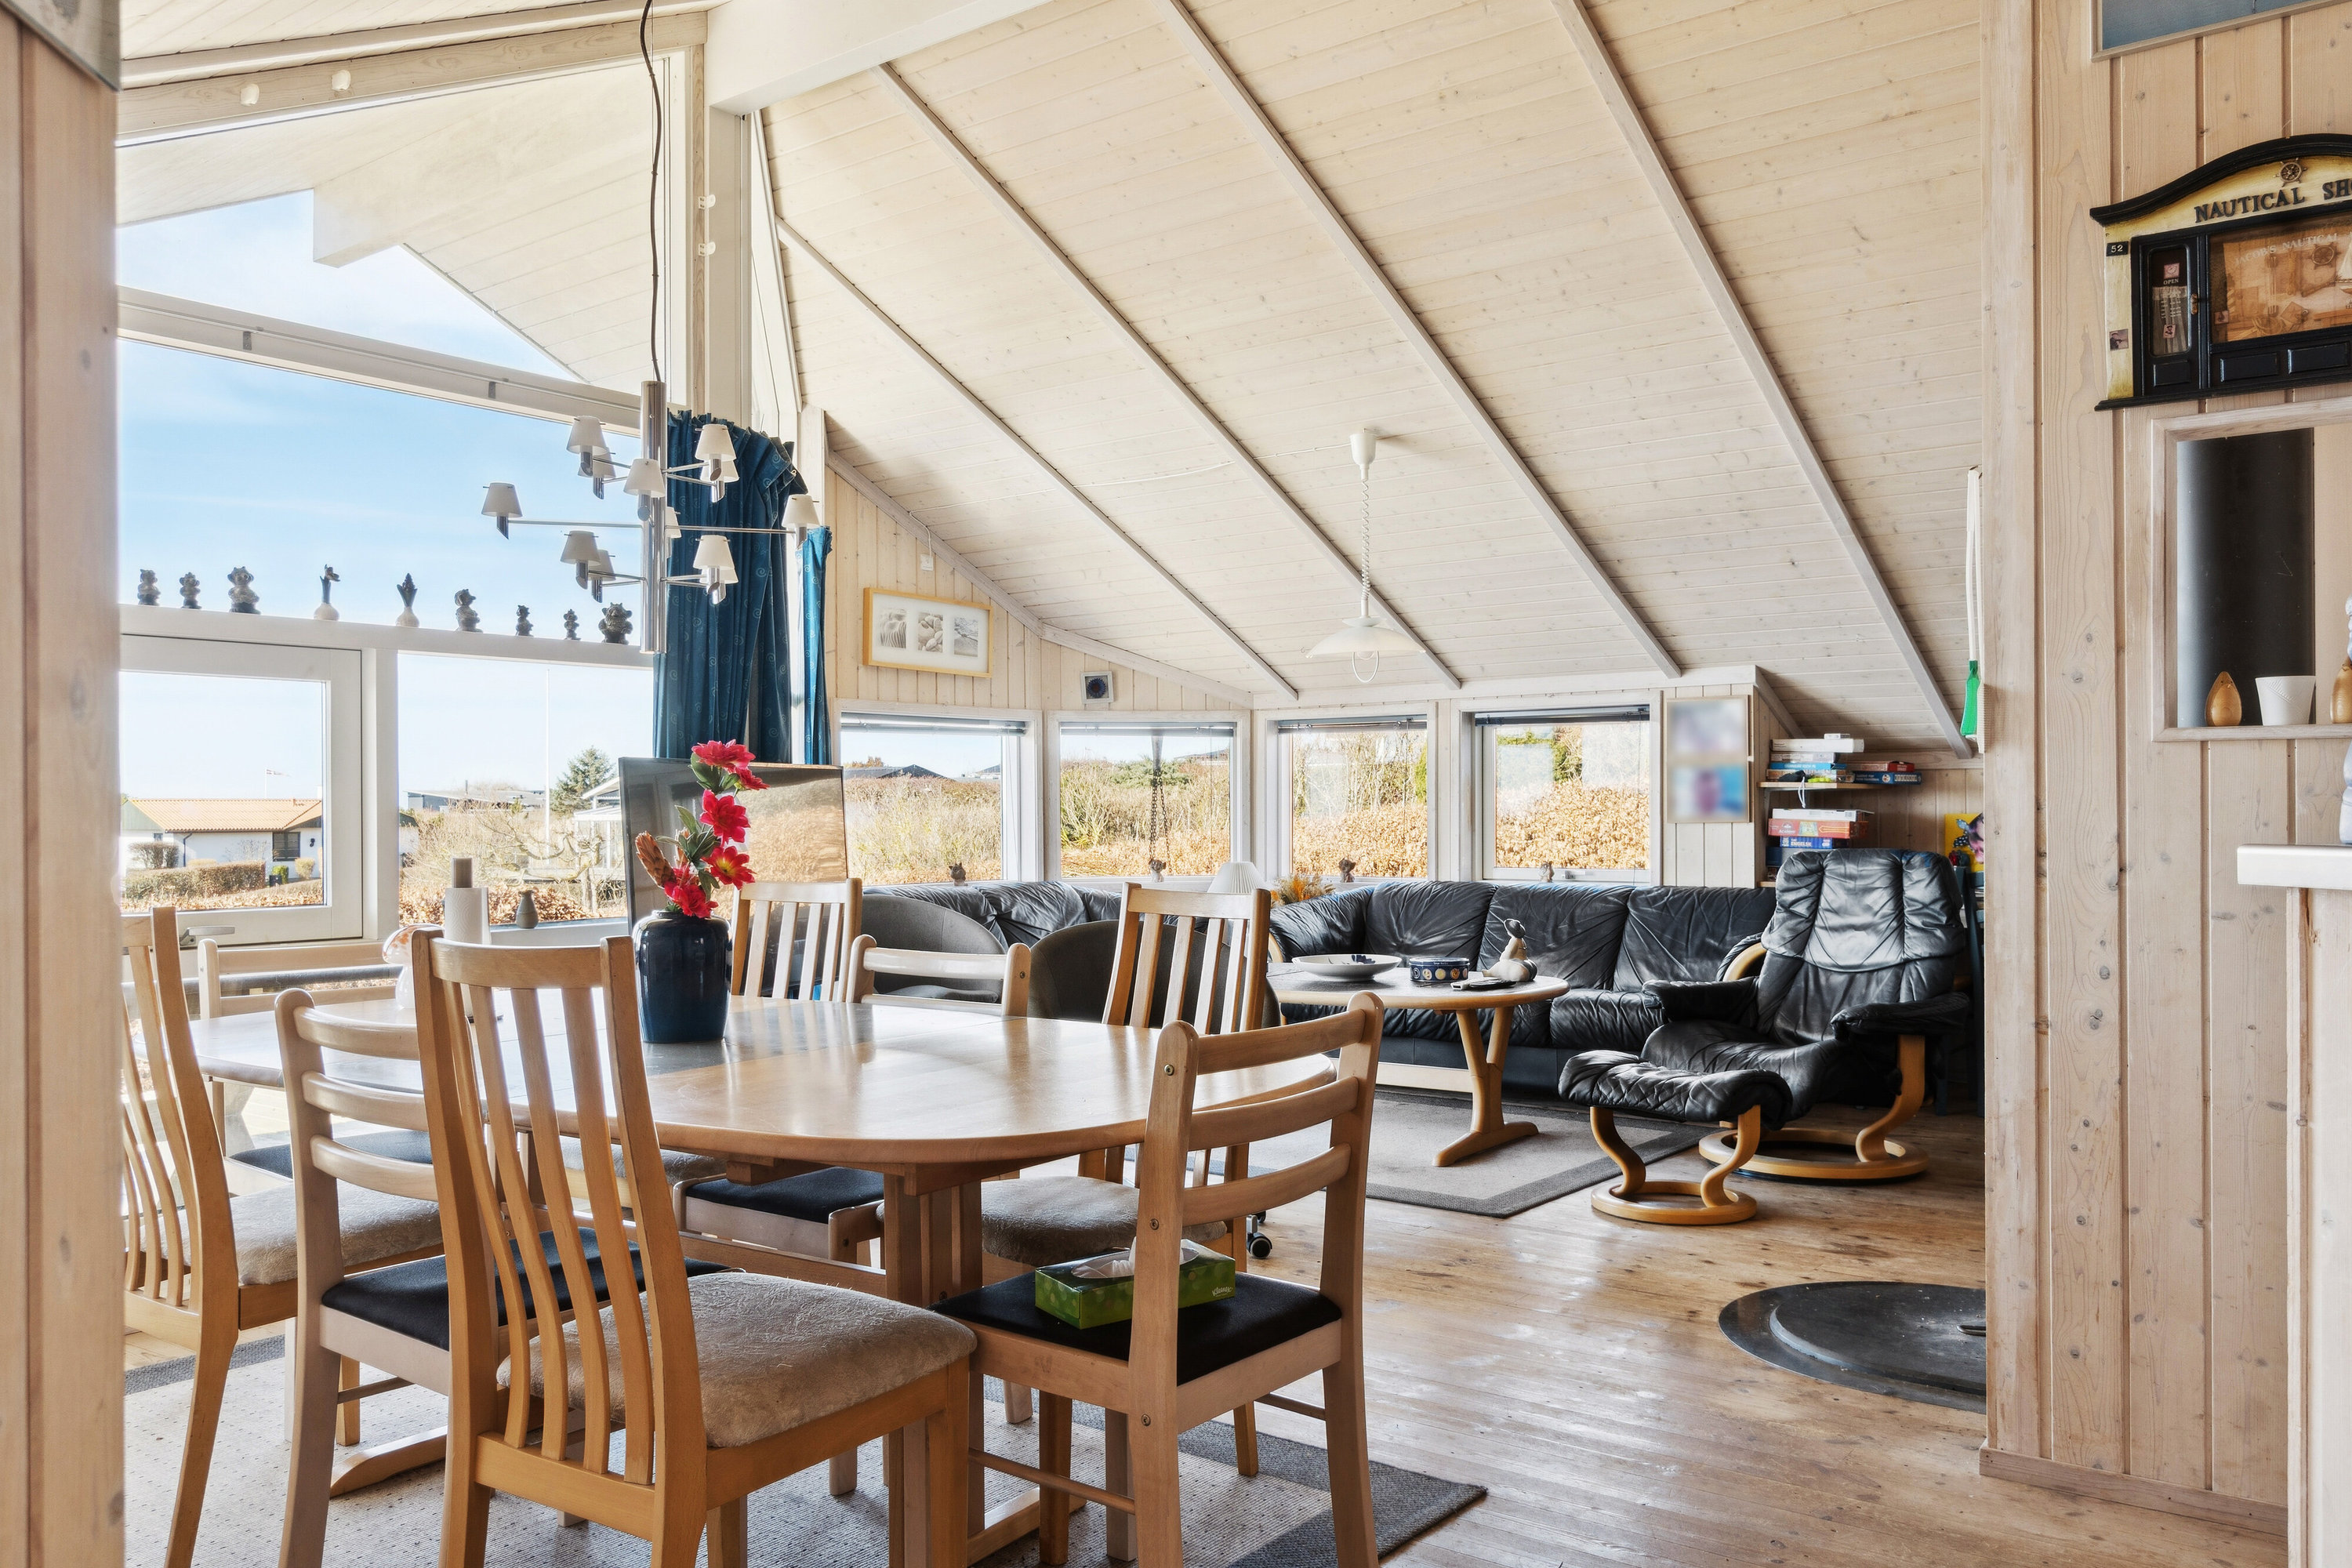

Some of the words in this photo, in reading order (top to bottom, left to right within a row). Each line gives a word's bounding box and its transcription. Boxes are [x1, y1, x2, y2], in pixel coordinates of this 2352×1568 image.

[2194, 187, 2305, 223] NAUTICAL
[2322, 179, 2352, 200] SH
[2282, 233, 2337, 250] NAUTICAL
